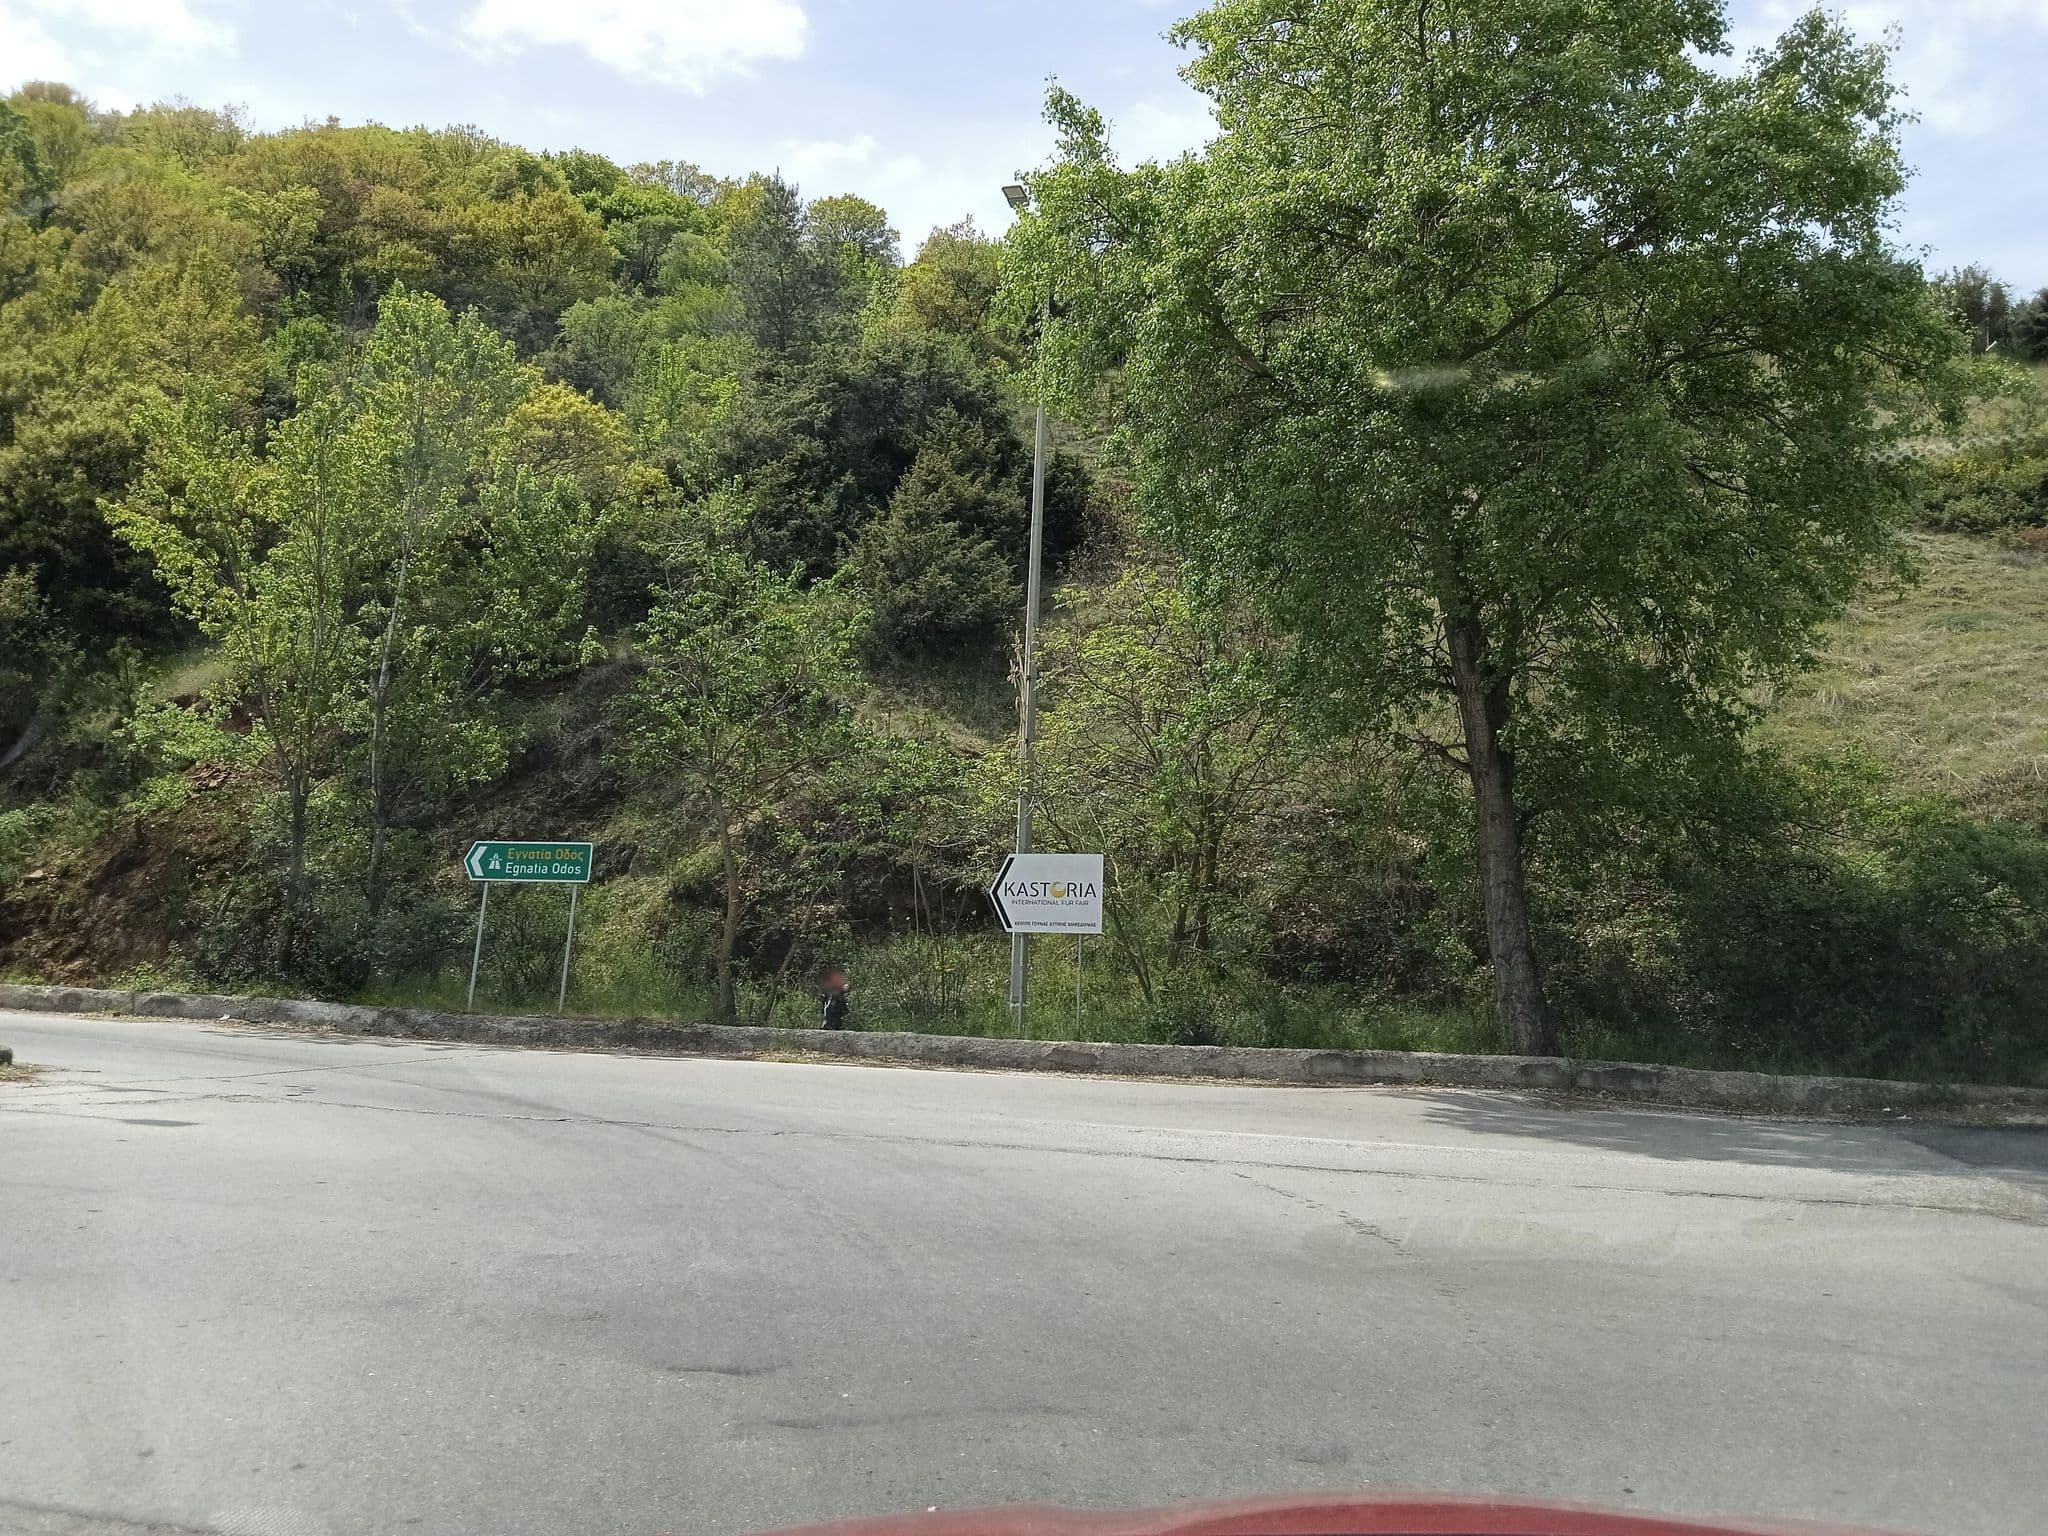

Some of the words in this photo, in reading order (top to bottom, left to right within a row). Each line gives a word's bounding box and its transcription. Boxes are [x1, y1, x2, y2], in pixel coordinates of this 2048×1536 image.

[505, 862, 548, 876] Egnatia
[552, 862, 582, 875] Odos
[1004, 881, 1097, 898] KASTORIA
